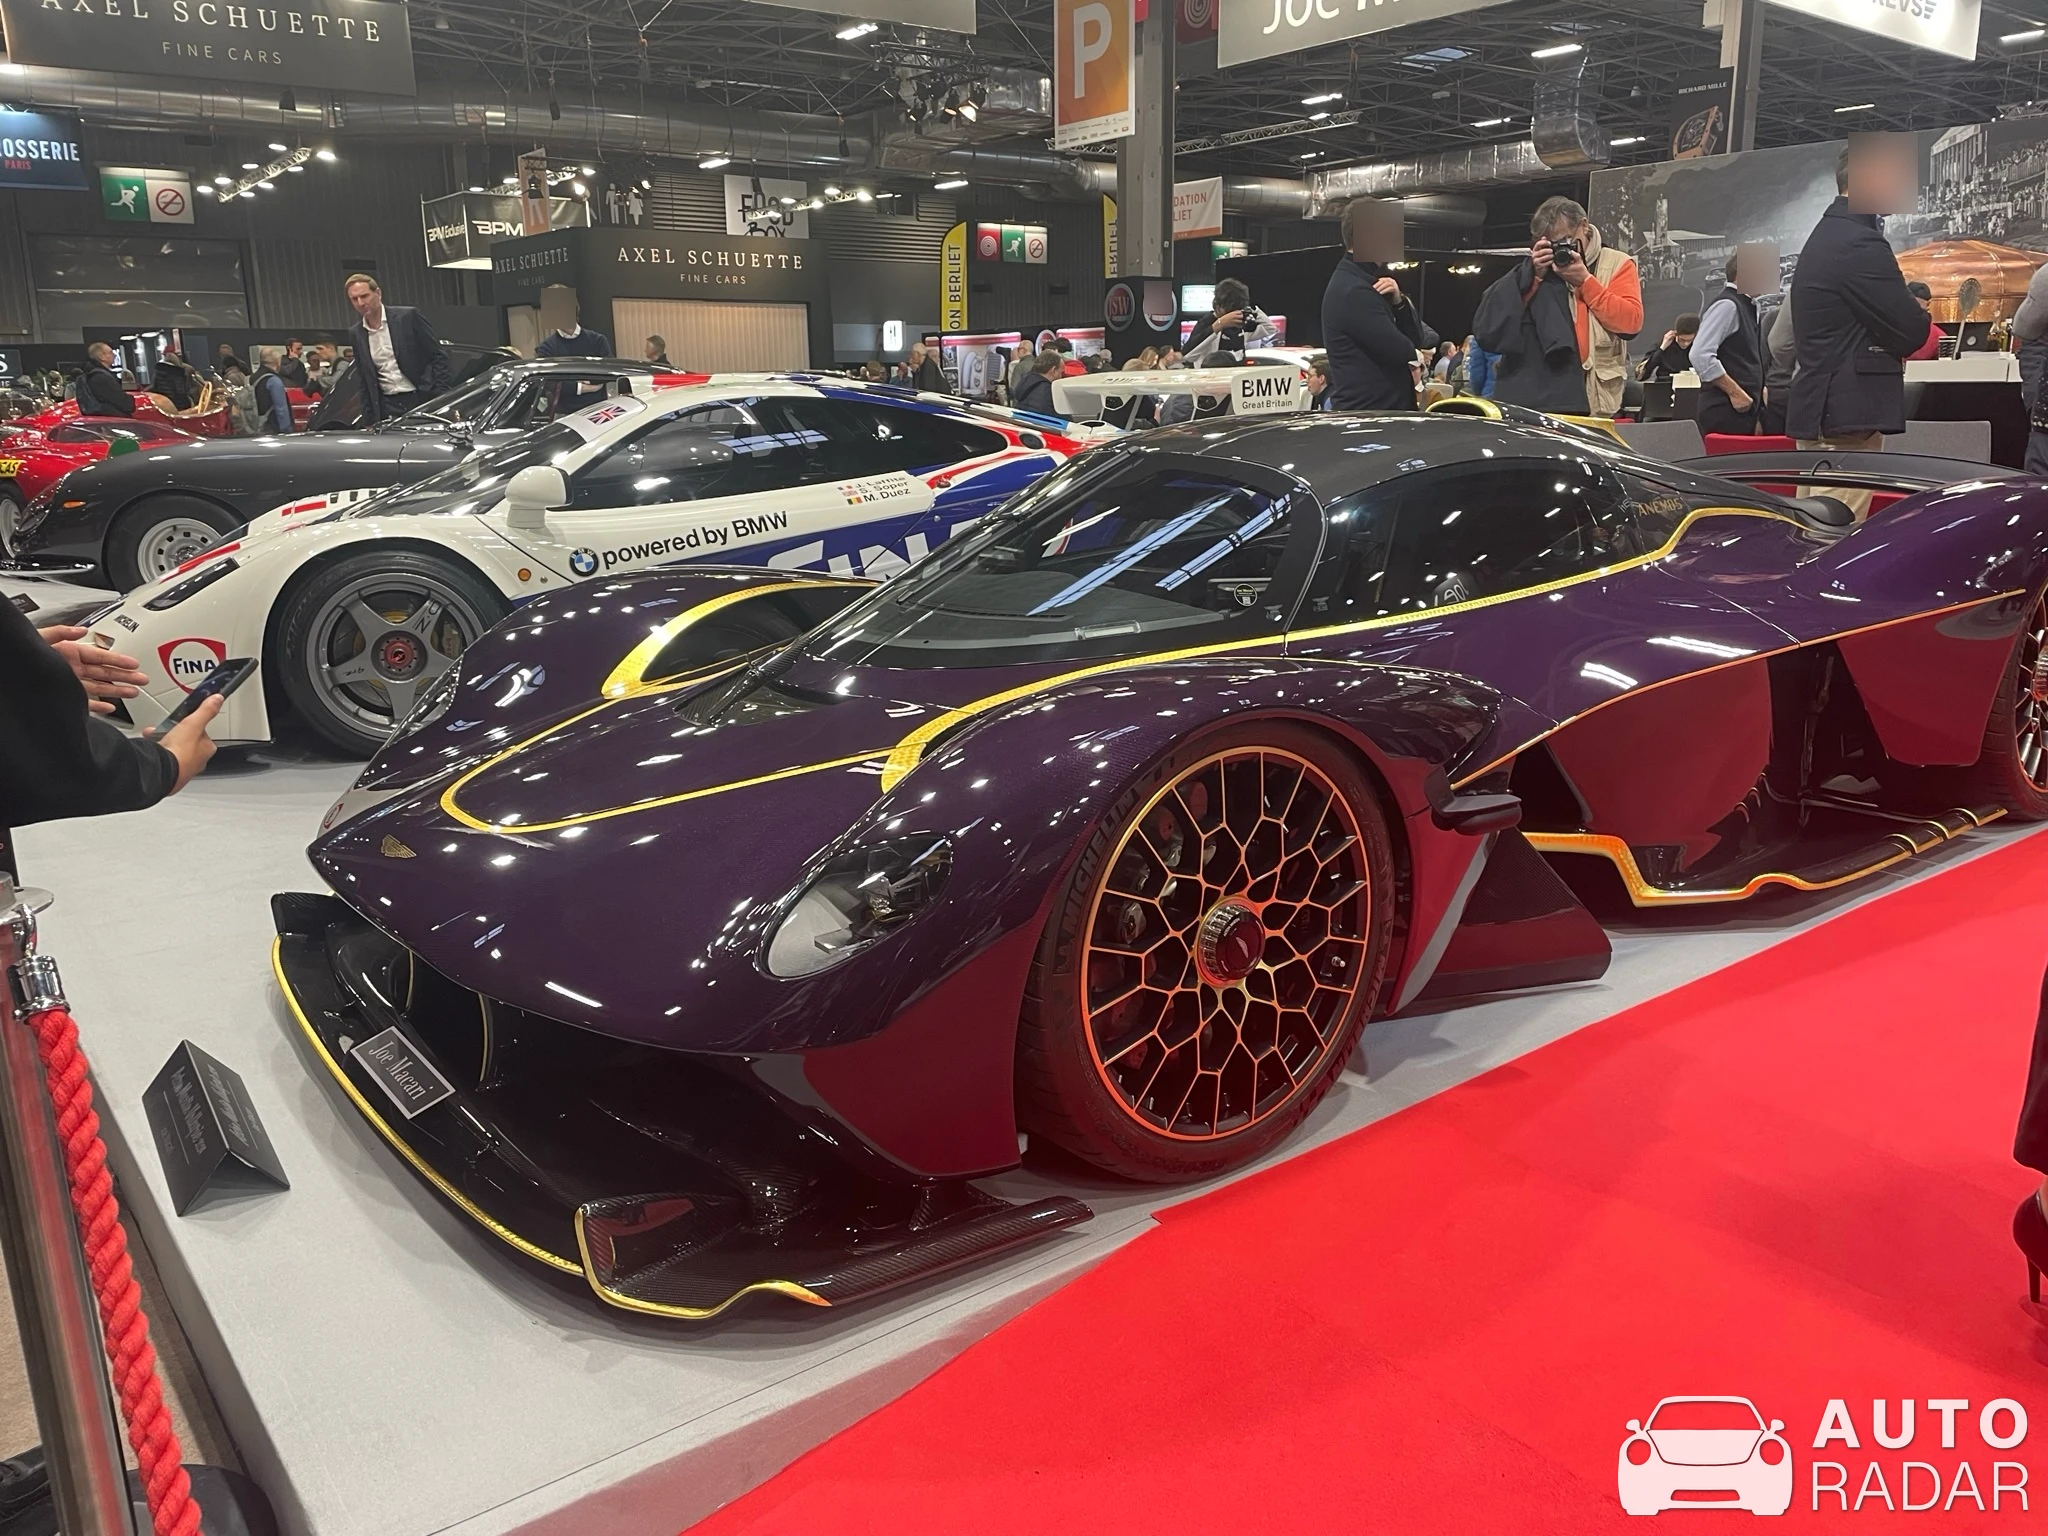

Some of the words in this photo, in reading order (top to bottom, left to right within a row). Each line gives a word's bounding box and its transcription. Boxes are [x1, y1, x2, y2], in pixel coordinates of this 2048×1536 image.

[173, 0, 380, 42] SCHUETTE
[162, 41, 213, 59] FINE
[228, 47, 282, 65] CARS
[1073, 2, 1113, 99] P
[1678, 85, 1707, 95] RICHARD
[1707, 82, 1728, 90] MILLE
[0, 137, 80, 162] OSSERIE
[4, 160, 32, 170] PARIS
[471, 220, 524, 237] BPM
[494, 258, 517, 275] AXEL
[519, 247, 569, 269] SCHUETTE
[617, 247, 676, 264] AXEL
[688, 249, 803, 270] SCHUETTE
[680, 273, 709, 284] FINE
[715, 275, 747, 285] CARS
[948, 244, 961, 303] BERLIET
[1241, 377, 1293, 398] BMW
[1242, 400, 1266, 410] Great
[1267, 399, 1293, 409] Britain
[863, 493, 878, 502] M.
[880, 488, 911, 499] Duez
[874, 481, 909, 491] Soper
[1638, 498, 1683, 516] ANEMOS
[602, 528, 700, 570] powered
[701, 526, 728, 546] by
[732, 510, 788, 538] BMW
[173, 657, 217, 674] FINA
[1063, 787, 1140, 935] MICHELIN
[368, 1041, 395, 1064] Joe
[386, 1056, 434, 1100] Macari
